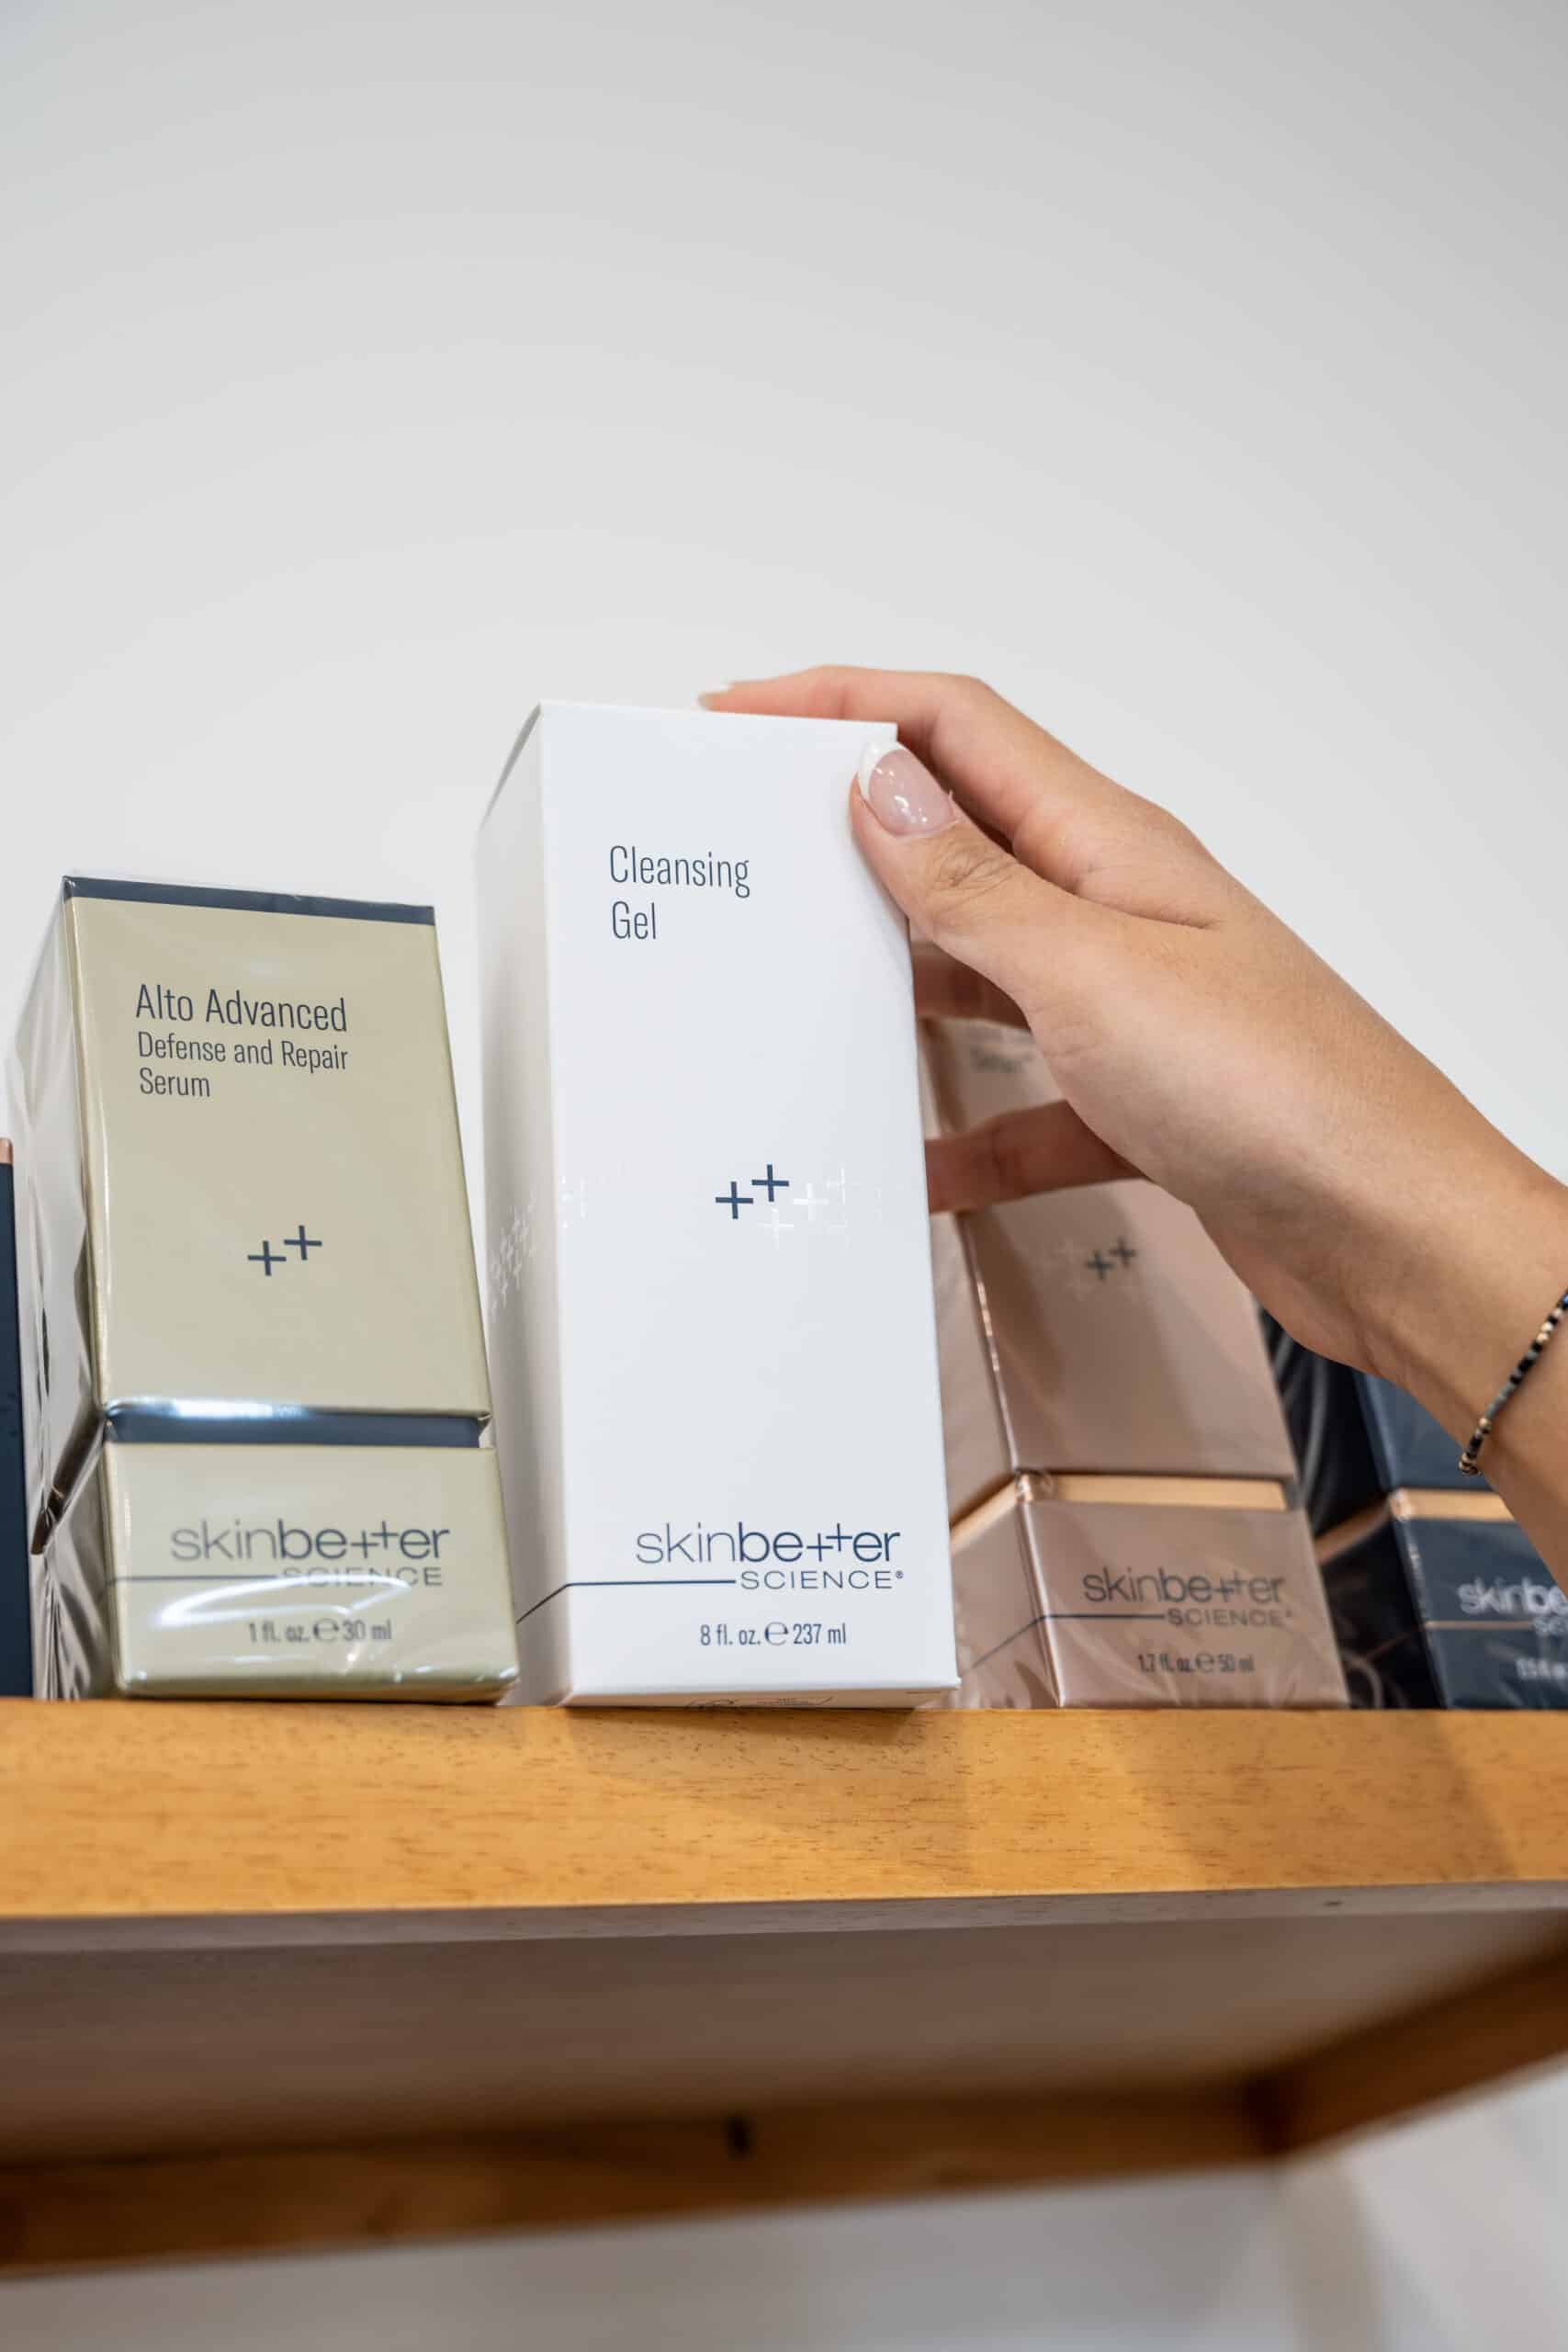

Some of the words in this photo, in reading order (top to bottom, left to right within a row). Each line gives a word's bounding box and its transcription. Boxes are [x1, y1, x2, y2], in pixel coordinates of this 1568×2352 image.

[609, 844, 750, 899] Cleansing
[612, 900, 657, 939] Gel
[136, 983, 193, 1022] Alto
[205, 988, 348, 1033] Advanced
[138, 1031, 227, 1062] Defense
[234, 1038, 273, 1065] and
[281, 1039, 349, 1073] Repair
[139, 1067, 211, 1098] Serum
[248, 1621, 257, 1643] 1
[342, 1619, 367, 1642] 30
[370, 1618, 393, 1641] ml
[699, 1623, 711, 1646] 8
[716, 1623, 733, 1645] fl.
[738, 1628, 761, 1646] oz.
[792, 1623, 823, 1645] 237
[827, 1622, 847, 1645] ml
